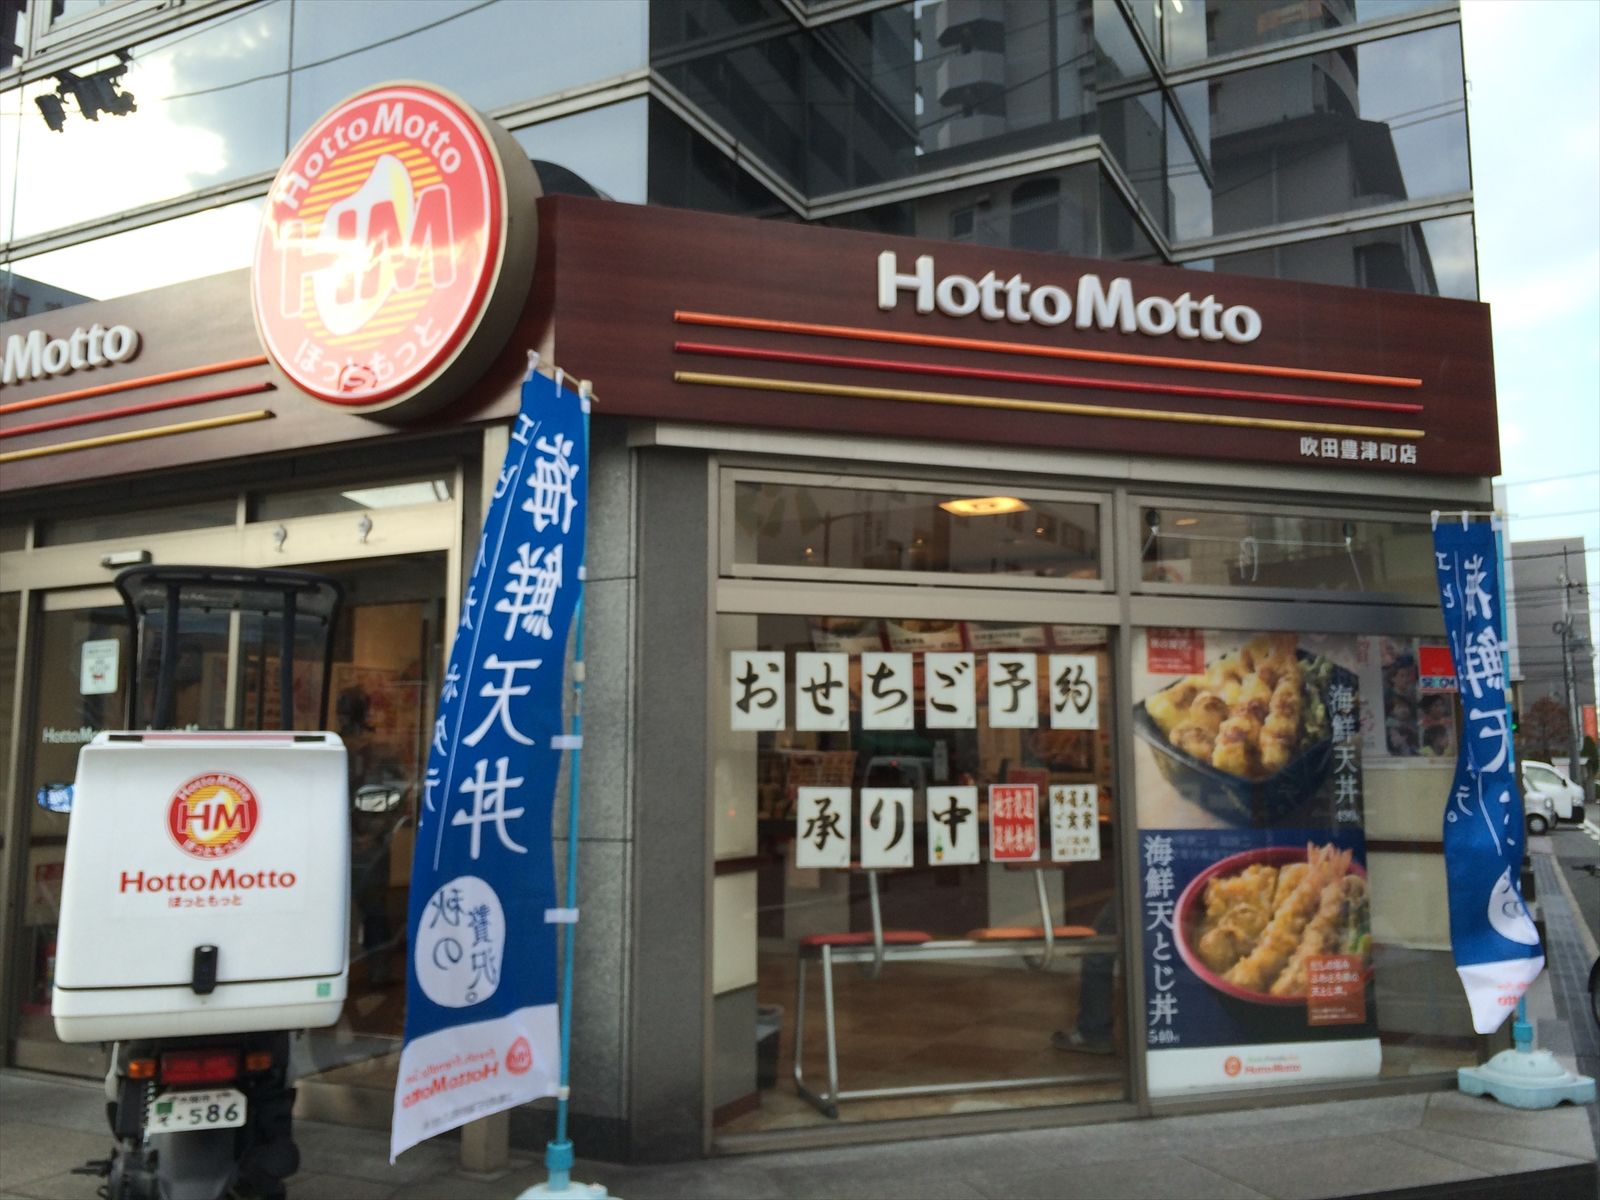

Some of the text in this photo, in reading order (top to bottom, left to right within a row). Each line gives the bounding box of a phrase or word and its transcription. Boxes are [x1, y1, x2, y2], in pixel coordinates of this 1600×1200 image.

[877, 250, 1263, 345] HottoMotto
[0, 322, 140, 385] Motto
[1299, 436, 1418, 466] 吹田豊津町店
[735, 660, 1093, 715] おせちご予約
[1329, 683, 1360, 806] 海鮮天丼
[802, 796, 972, 852] 承り中
[119, 868, 296, 893] HottoMotto
[1144, 835, 1179, 1026] 海鮮天とじ丼
